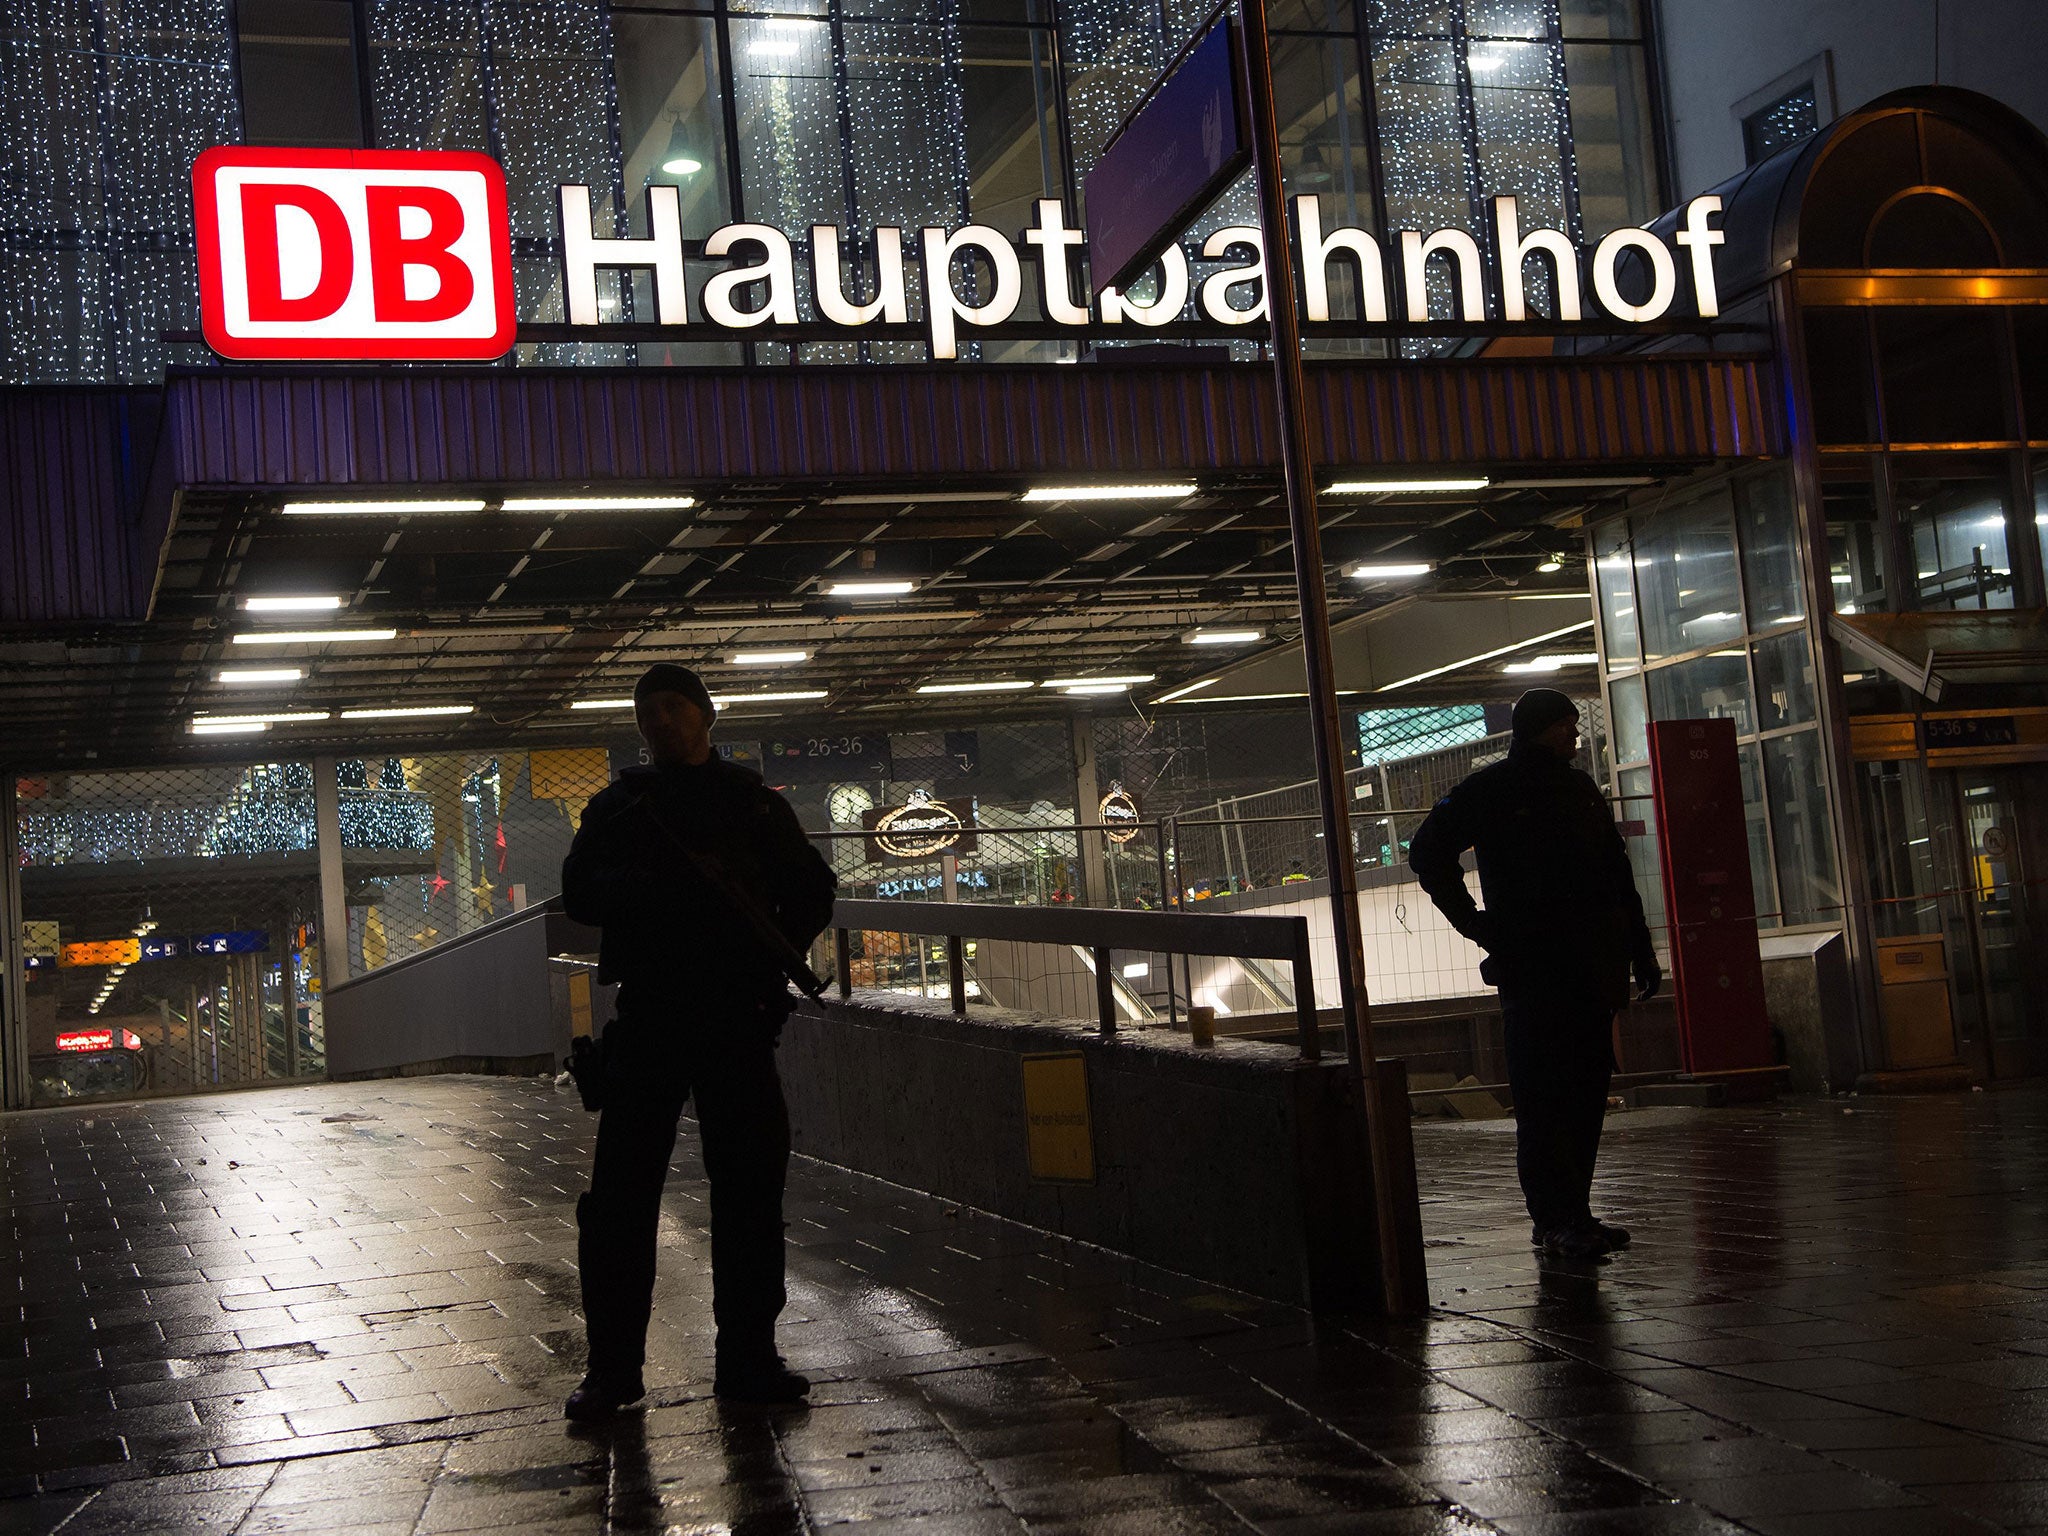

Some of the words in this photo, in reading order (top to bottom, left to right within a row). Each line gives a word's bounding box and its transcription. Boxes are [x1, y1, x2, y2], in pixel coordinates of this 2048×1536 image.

[239, 183, 475, 323] DB
[559, 184, 1725, 360] Hauptbahnhof
[1928, 720, 1962, 737] 5-36
[807, 736, 863, 757] 26-36
[1689, 748, 1710, 760] SOS
